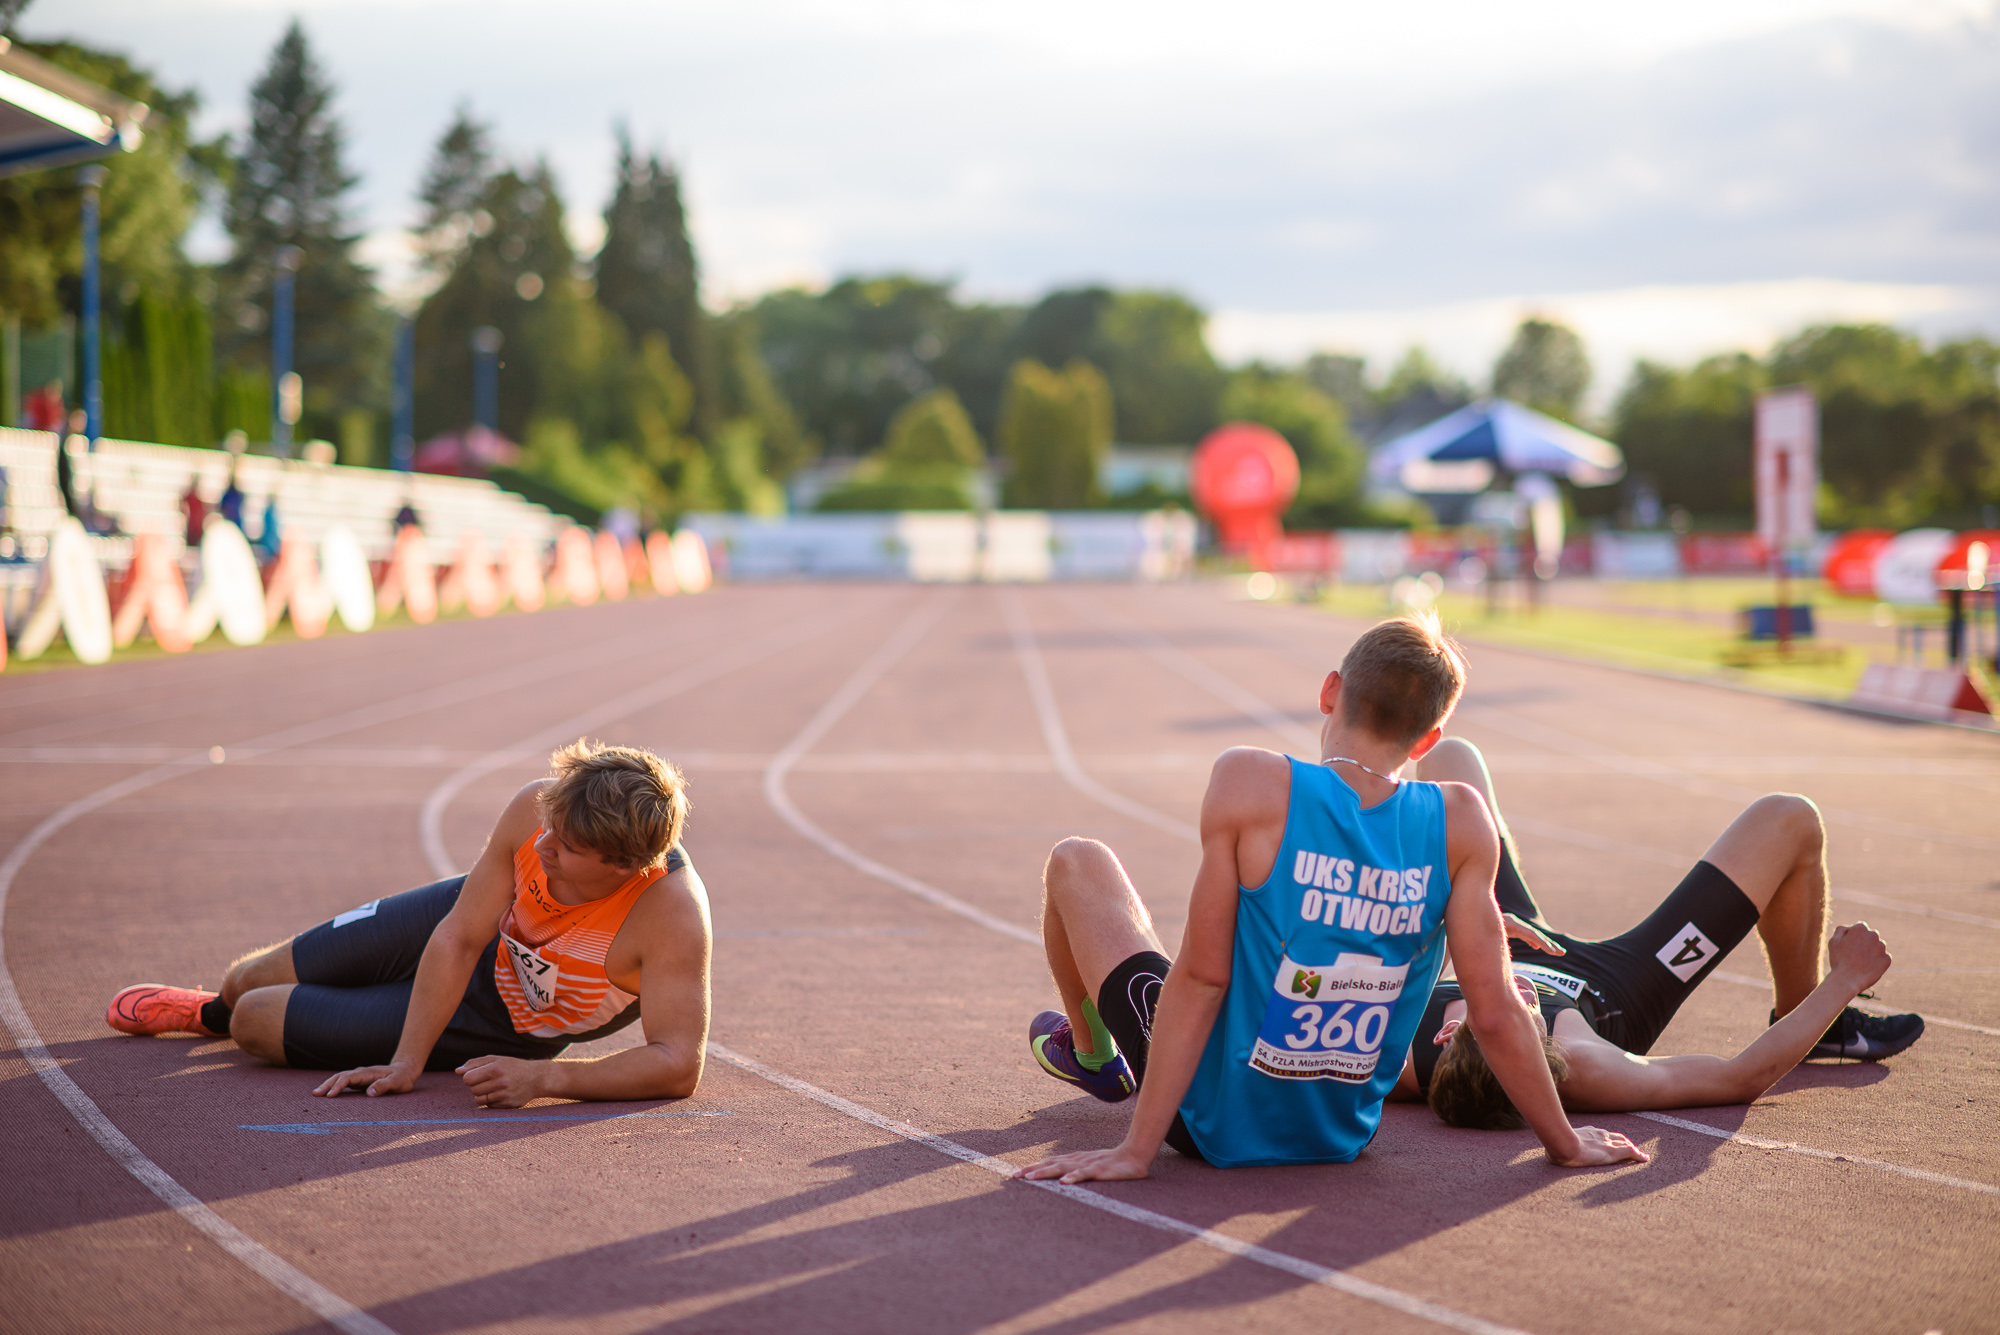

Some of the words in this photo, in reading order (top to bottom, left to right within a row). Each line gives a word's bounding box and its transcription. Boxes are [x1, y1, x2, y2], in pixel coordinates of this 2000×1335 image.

[1293, 850, 1355, 893] UKS
[1300, 888, 1426, 936] OTWOCK
[506, 939, 552, 976] 367
[1668, 935, 1706, 968] 4
[1284, 1002, 1390, 1053] 360
[1272, 1055, 1295, 1067] PZLA
[1298, 1058, 1354, 1069] Mistrzostwa
